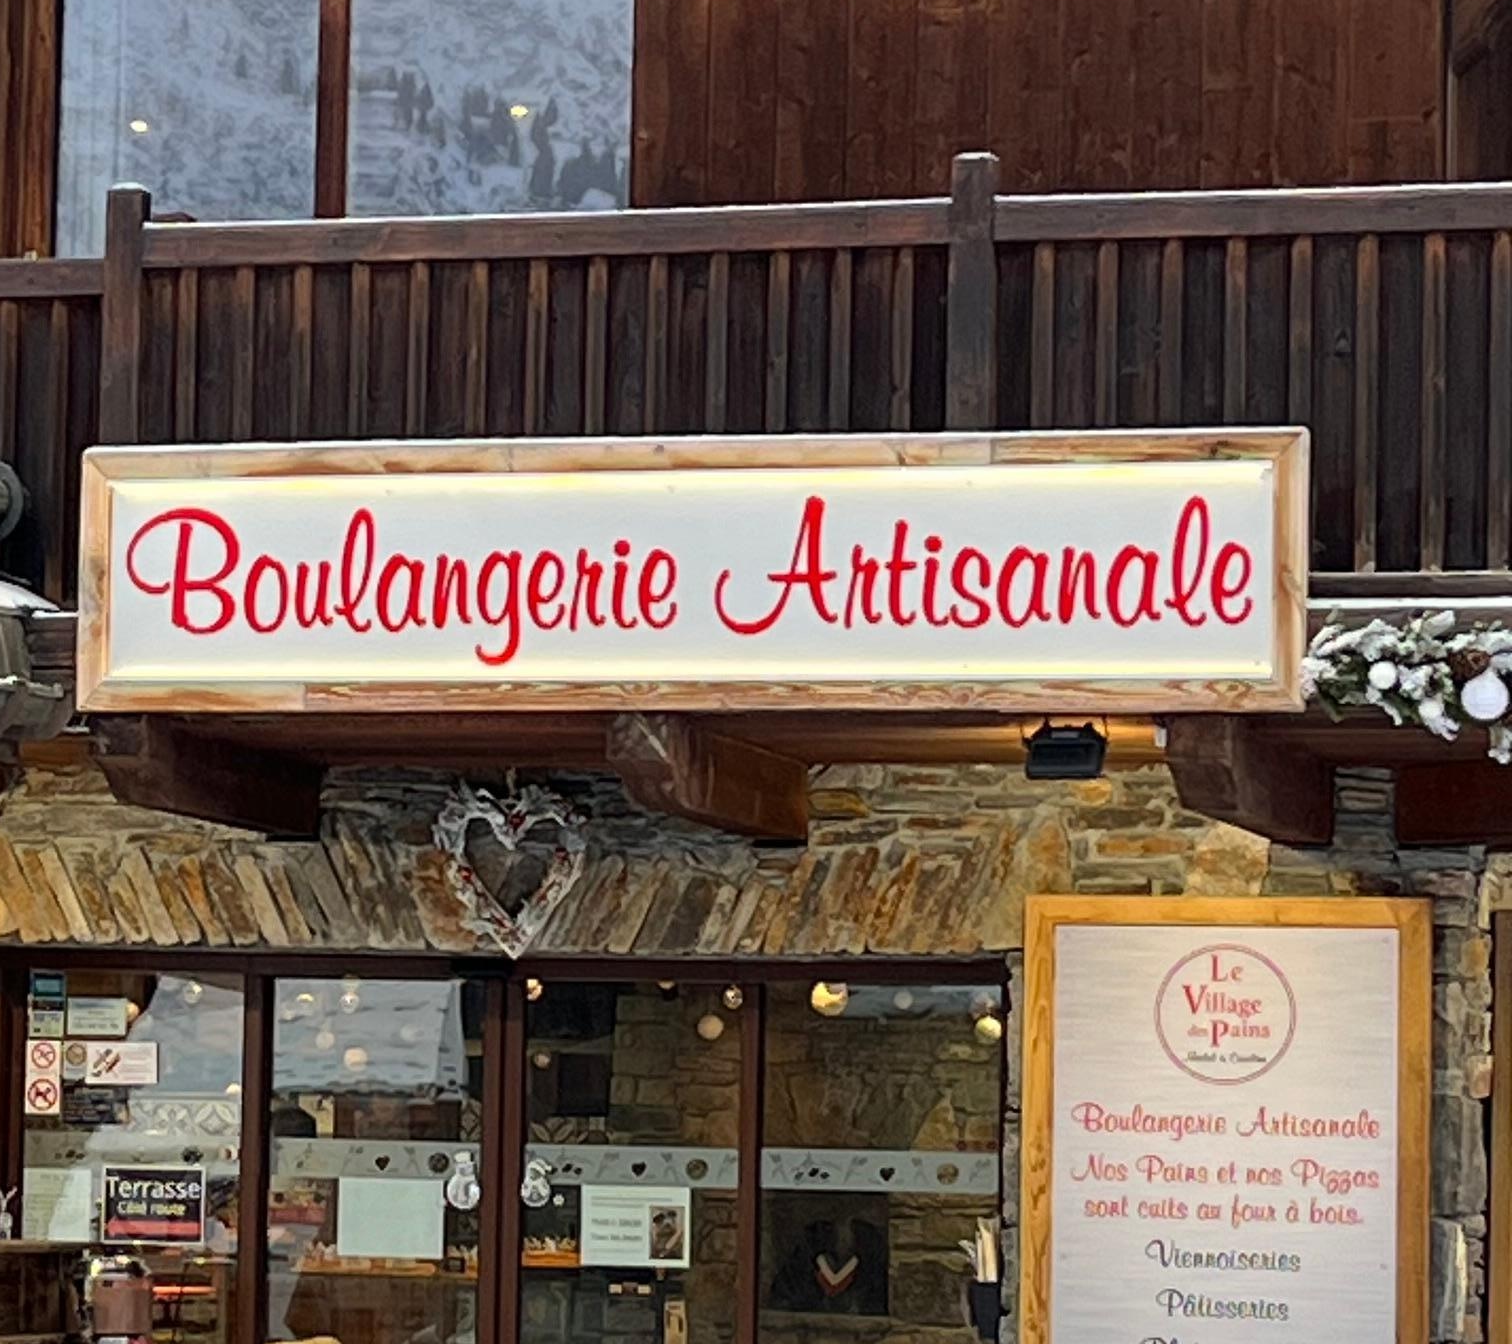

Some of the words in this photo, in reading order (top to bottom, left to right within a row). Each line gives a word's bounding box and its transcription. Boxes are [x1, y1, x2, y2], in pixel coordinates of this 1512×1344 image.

[126, 506, 678, 666] Boulangerie
[713, 495, 1254, 636] Artisanale
[1211, 953, 1244, 982] Le
[1182, 983, 1263, 1019] Village
[1209, 1018, 1271, 1048] Pains
[1071, 1102, 1227, 1141] Boulangerie
[1236, 1106, 1381, 1138] Artisanale
[106, 1176, 201, 1198] Terrasse
[1071, 1154, 1129, 1182] Nos
[1136, 1154, 1209, 1184] Pains
[1217, 1162, 1237, 1184] et
[1246, 1168, 1283, 1185] nos
[1291, 1159, 1380, 1195] Pizzas
[1084, 1195, 1129, 1218] sont
[1138, 1198, 1188, 1220] cuits
[1197, 1203, 1221, 1220] au
[1231, 1193, 1277, 1229] four
[1286, 1200, 1299, 1224] à
[1145, 1239, 1301, 1272] Viennoiseries
[1156, 1288, 1289, 1321] Pâtisseries
